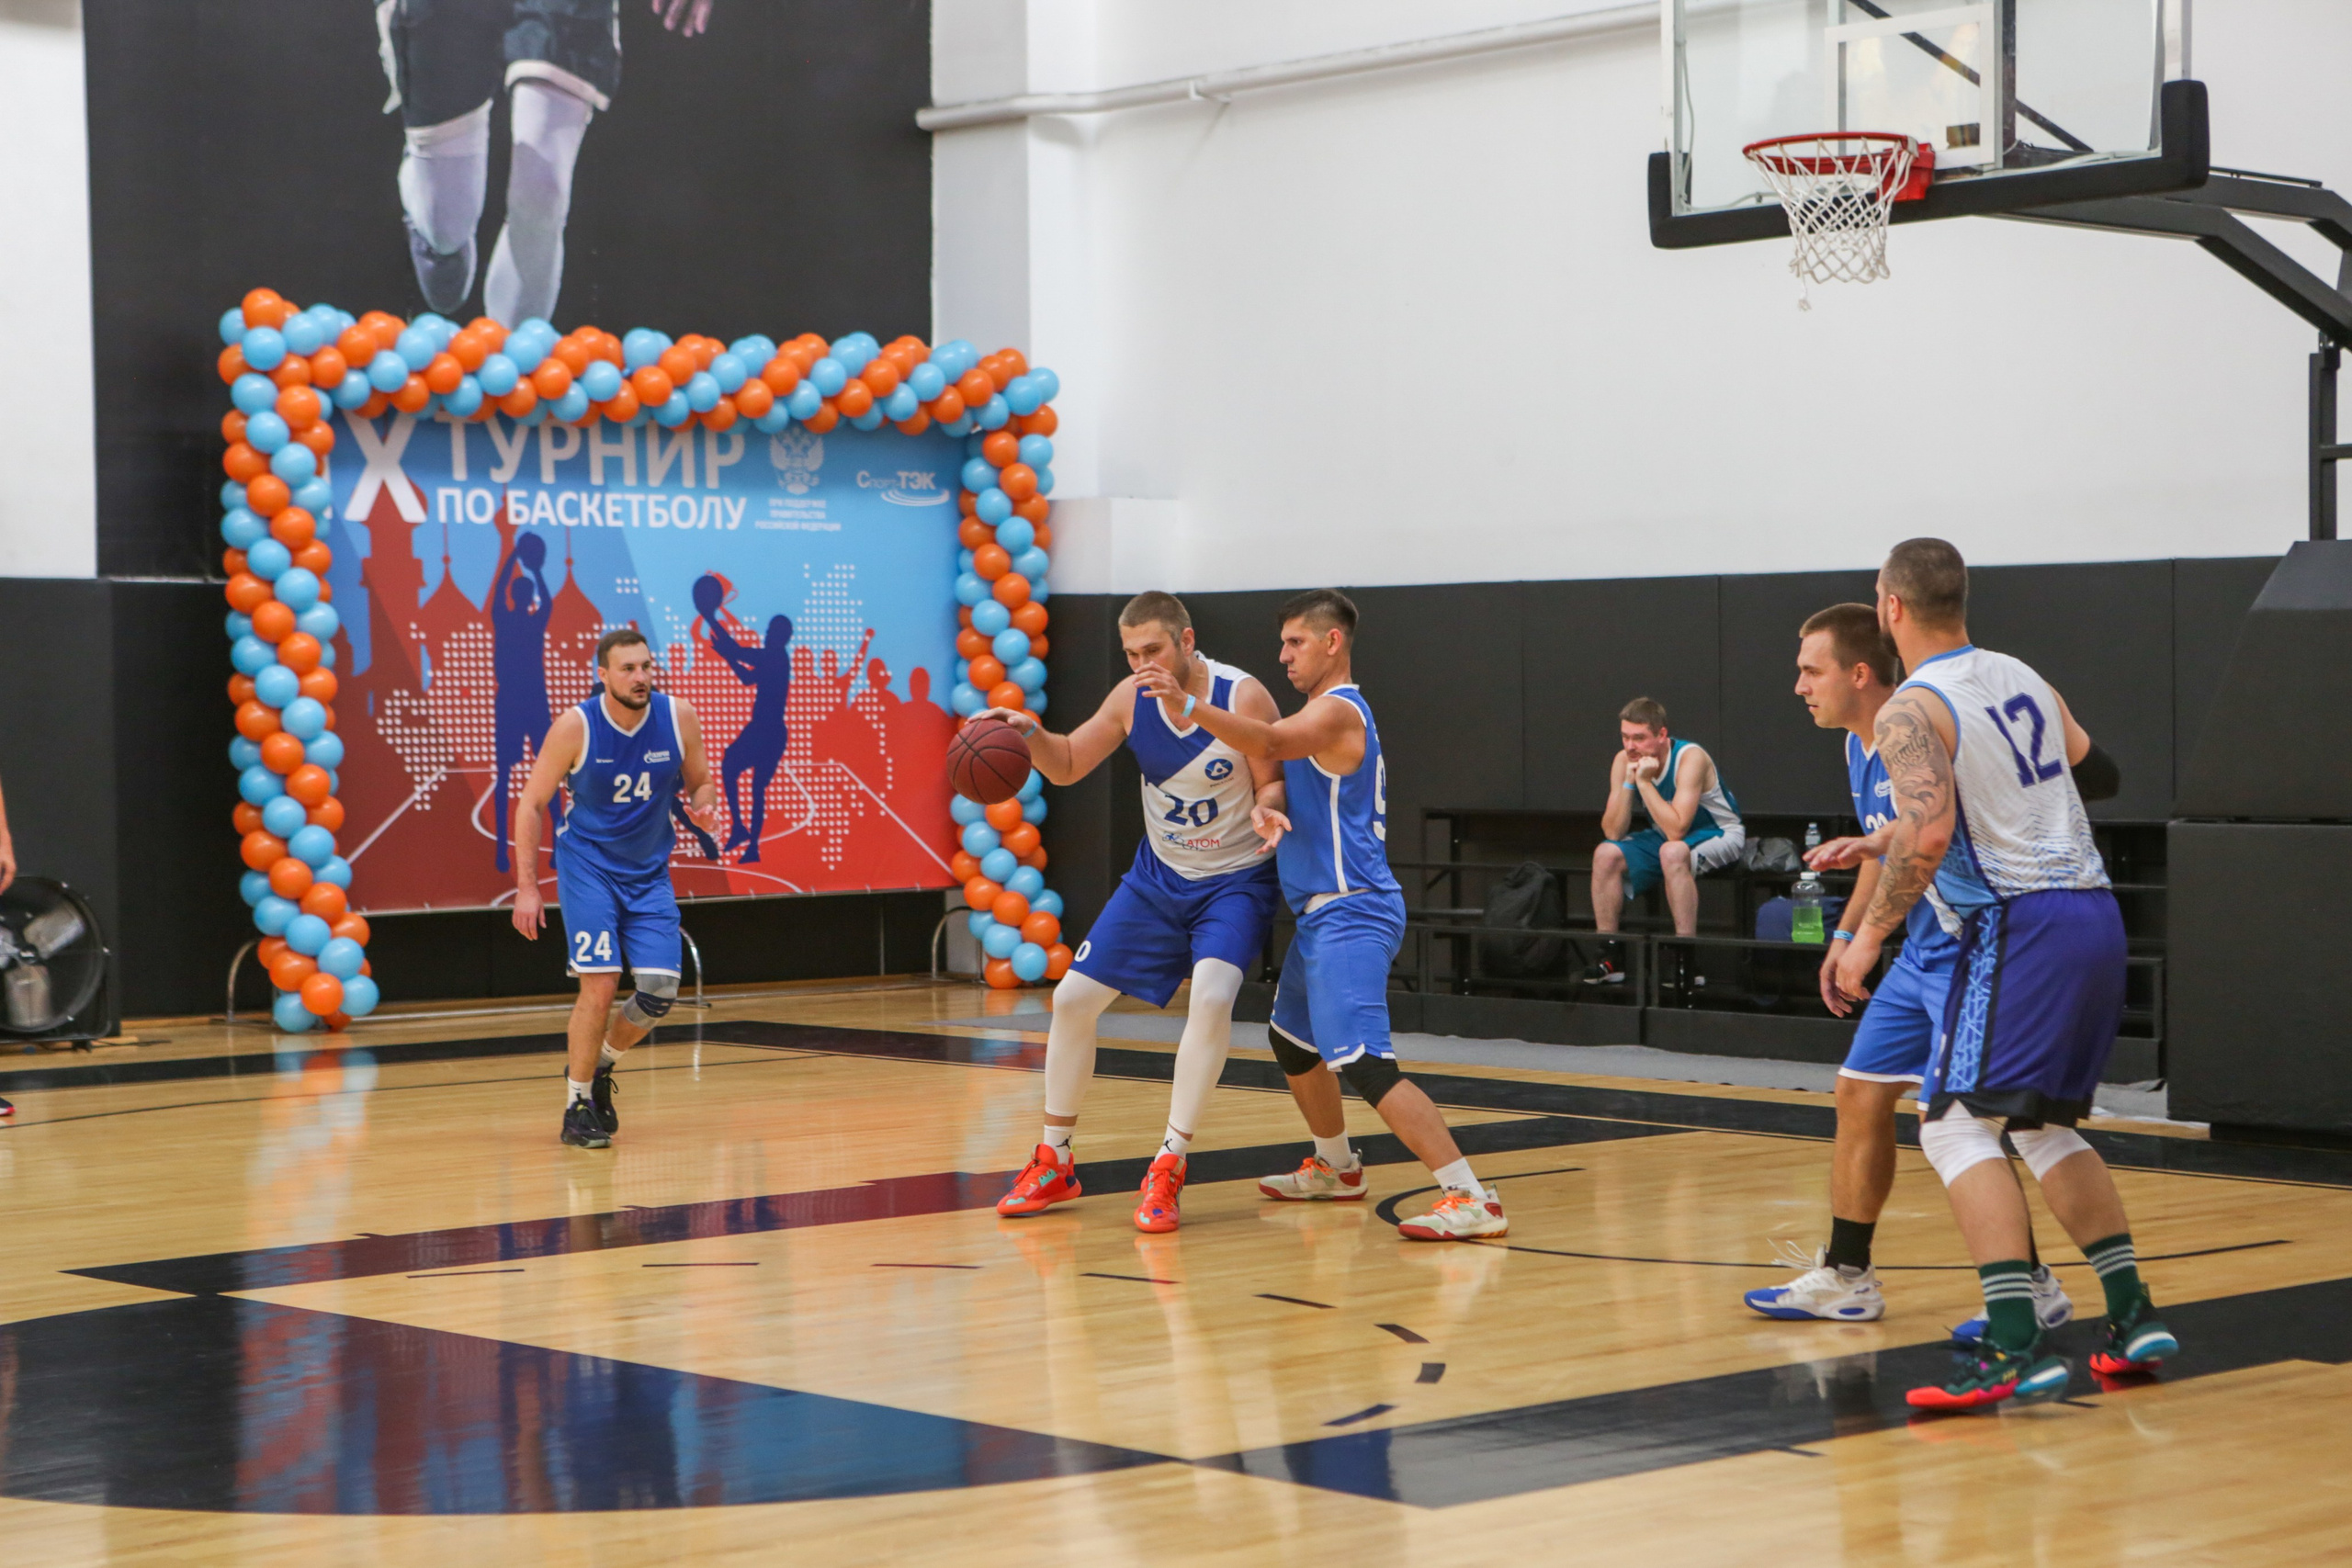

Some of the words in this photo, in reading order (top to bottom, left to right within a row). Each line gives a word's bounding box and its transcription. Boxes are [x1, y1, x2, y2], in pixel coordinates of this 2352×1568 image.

[435, 411, 745, 490] ТУРНИР
[436, 488, 495, 525] ПО
[507, 490, 747, 530] БАСКЕТБОЛУ
[1984, 693, 2063, 788] 12
[613, 772, 652, 804] 24
[1163, 795, 1219, 828] 20
[575, 931, 613, 962] 24
